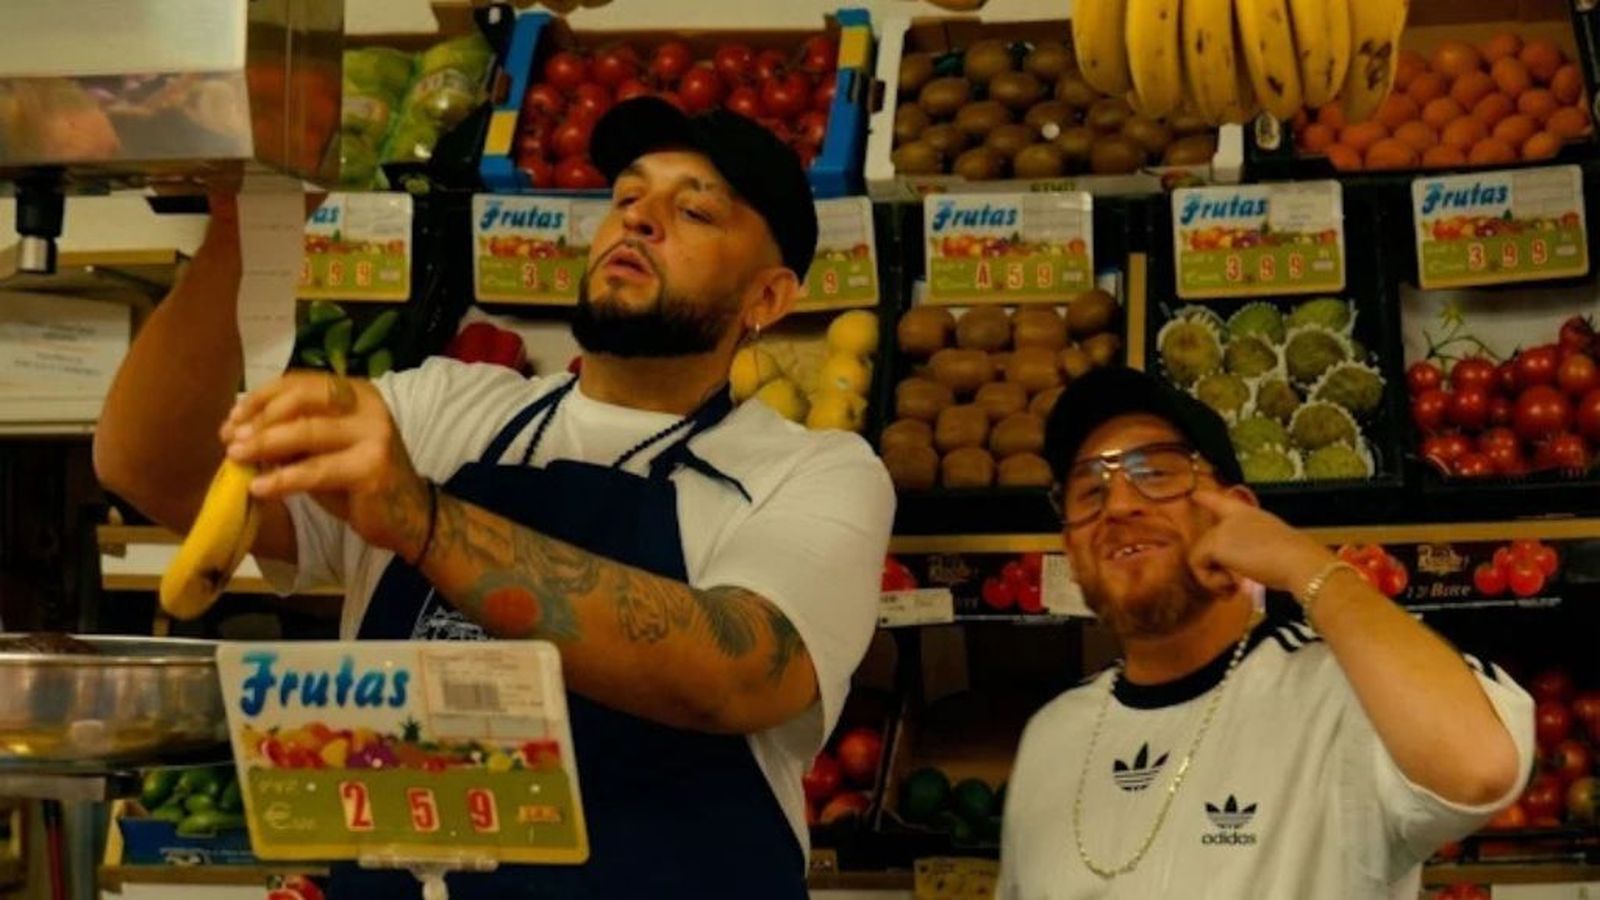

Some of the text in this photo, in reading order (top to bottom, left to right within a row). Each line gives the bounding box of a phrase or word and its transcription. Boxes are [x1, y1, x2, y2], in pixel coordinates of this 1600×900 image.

[1180, 192, 1268, 225] Frutas
[1422, 182, 1508, 214] Frutas
[481, 200, 564, 231] Frutas
[932, 200, 1018, 231] Frutas
[240, 651, 409, 717] Frutas
[1201, 831, 1257, 846] adidas
